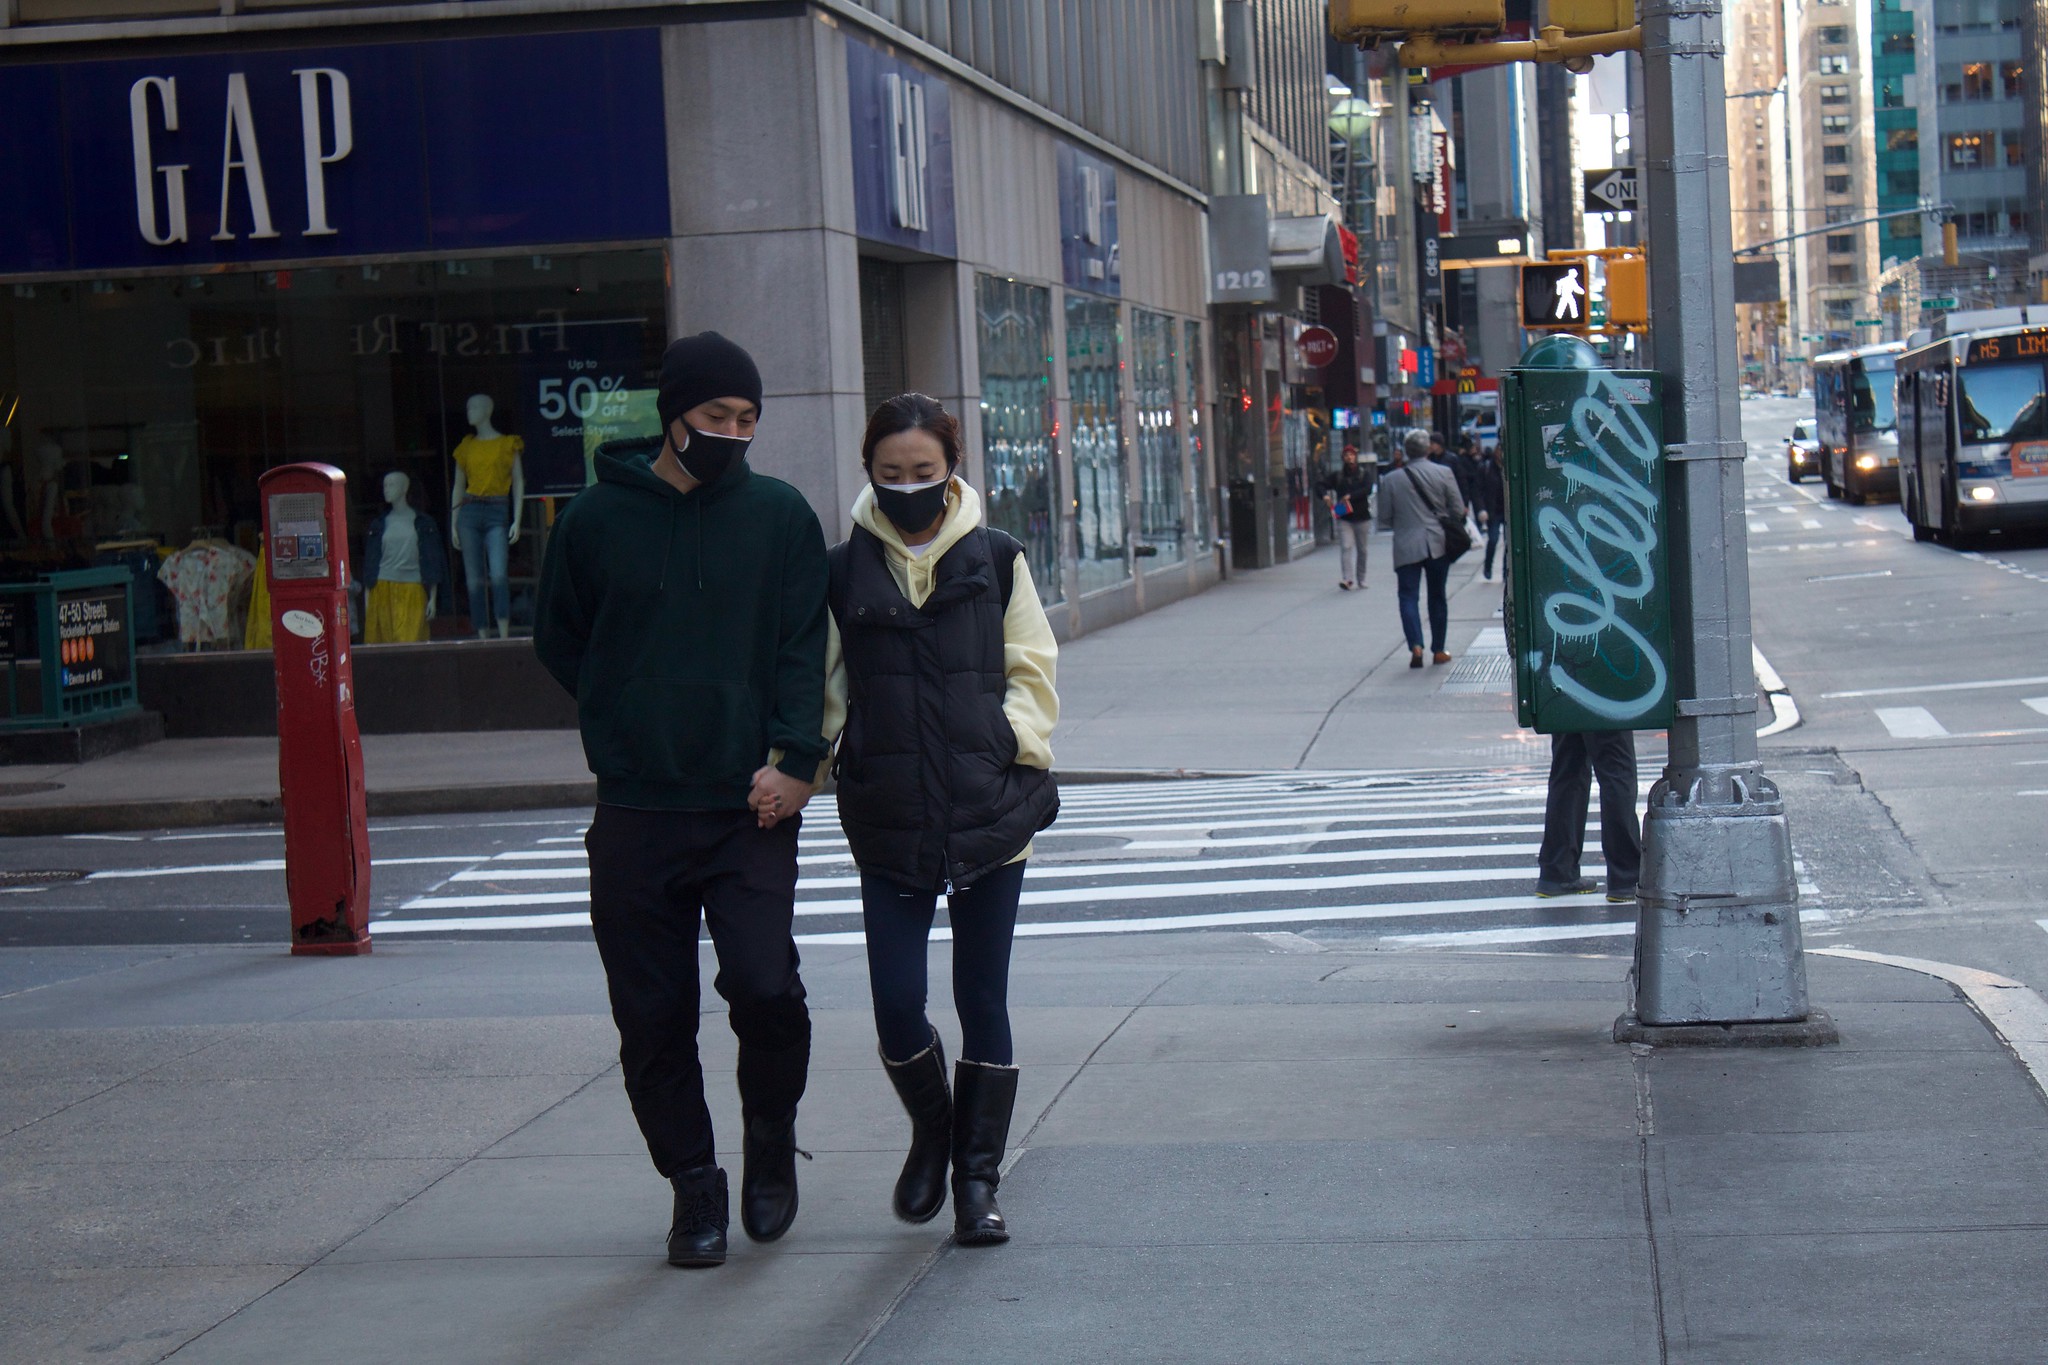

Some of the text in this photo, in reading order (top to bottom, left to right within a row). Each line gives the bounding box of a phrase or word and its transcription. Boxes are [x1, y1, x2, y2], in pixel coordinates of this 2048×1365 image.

[129, 67, 354, 246] GAP
[1432, 135, 1447, 214] McDonald's
[1216, 270, 1266, 289] 1212
[2017, 336, 2048, 355] LIM
[568, 360, 598, 370] Up to
[539, 375, 628, 420] 50%
[601, 405, 628, 417] OFF
[551, 425, 619, 437] Select Styles
[59, 601, 107, 624] 47-50 Streets
[103, 618, 120, 633] Station
